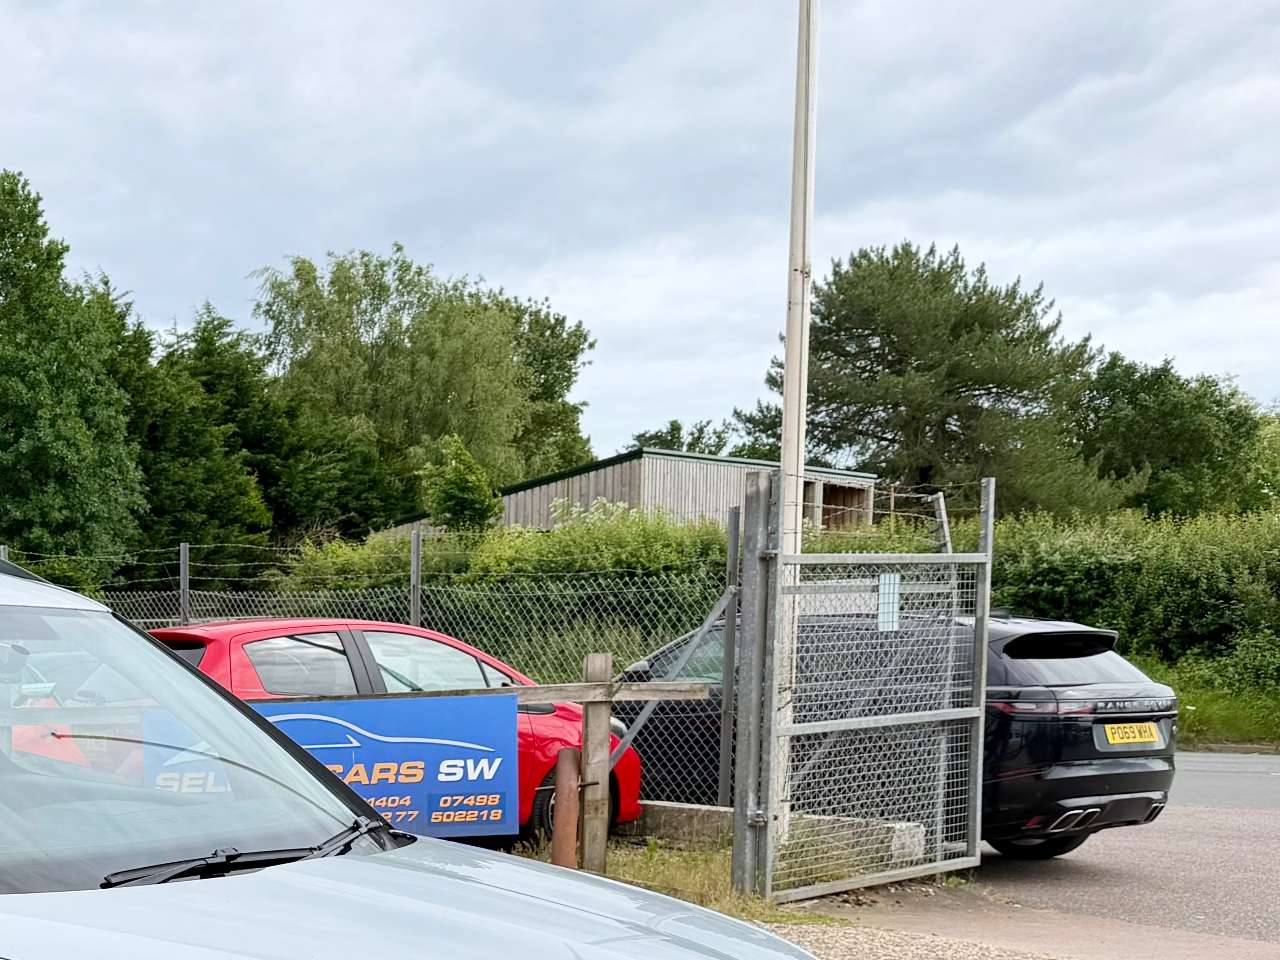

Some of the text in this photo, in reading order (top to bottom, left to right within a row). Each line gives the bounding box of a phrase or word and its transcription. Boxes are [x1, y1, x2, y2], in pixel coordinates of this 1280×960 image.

[154, 771, 232, 793] SEL
[437, 757, 503, 782] SW
[367, 795, 412, 807] 1404
[439, 794, 500, 808] 07498
[430, 809, 503, 823] 502218
